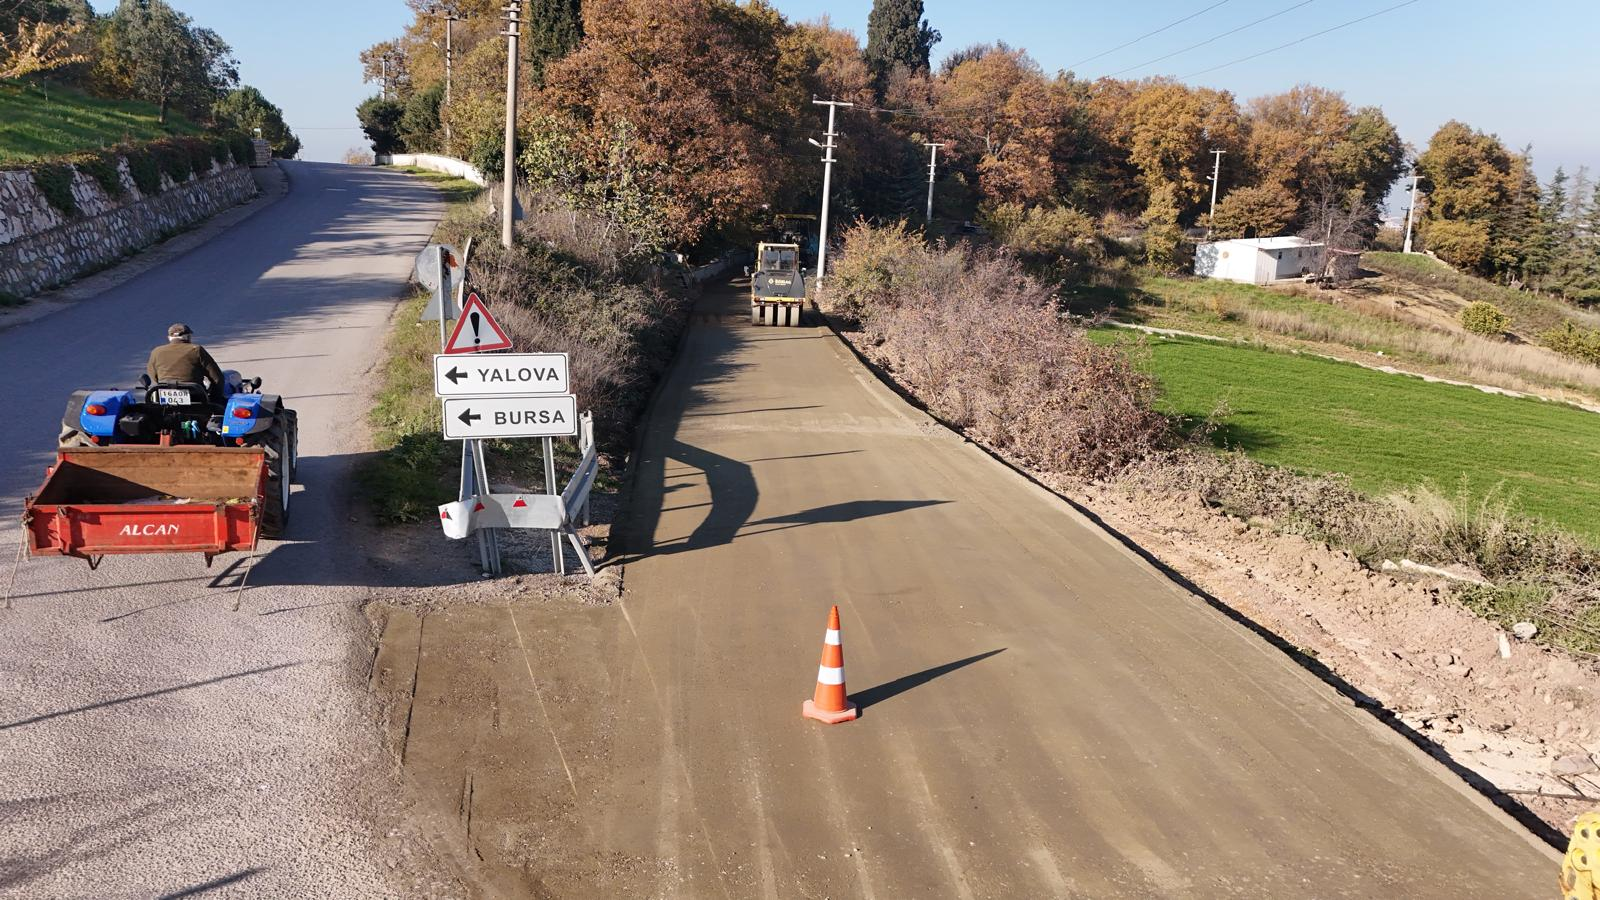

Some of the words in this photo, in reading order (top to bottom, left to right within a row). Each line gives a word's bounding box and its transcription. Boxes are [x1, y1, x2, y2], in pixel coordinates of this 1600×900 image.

[478, 367, 560, 382] YALOVA
[494, 410, 566, 425] BURSA
[119, 524, 180, 536] ALCAN
